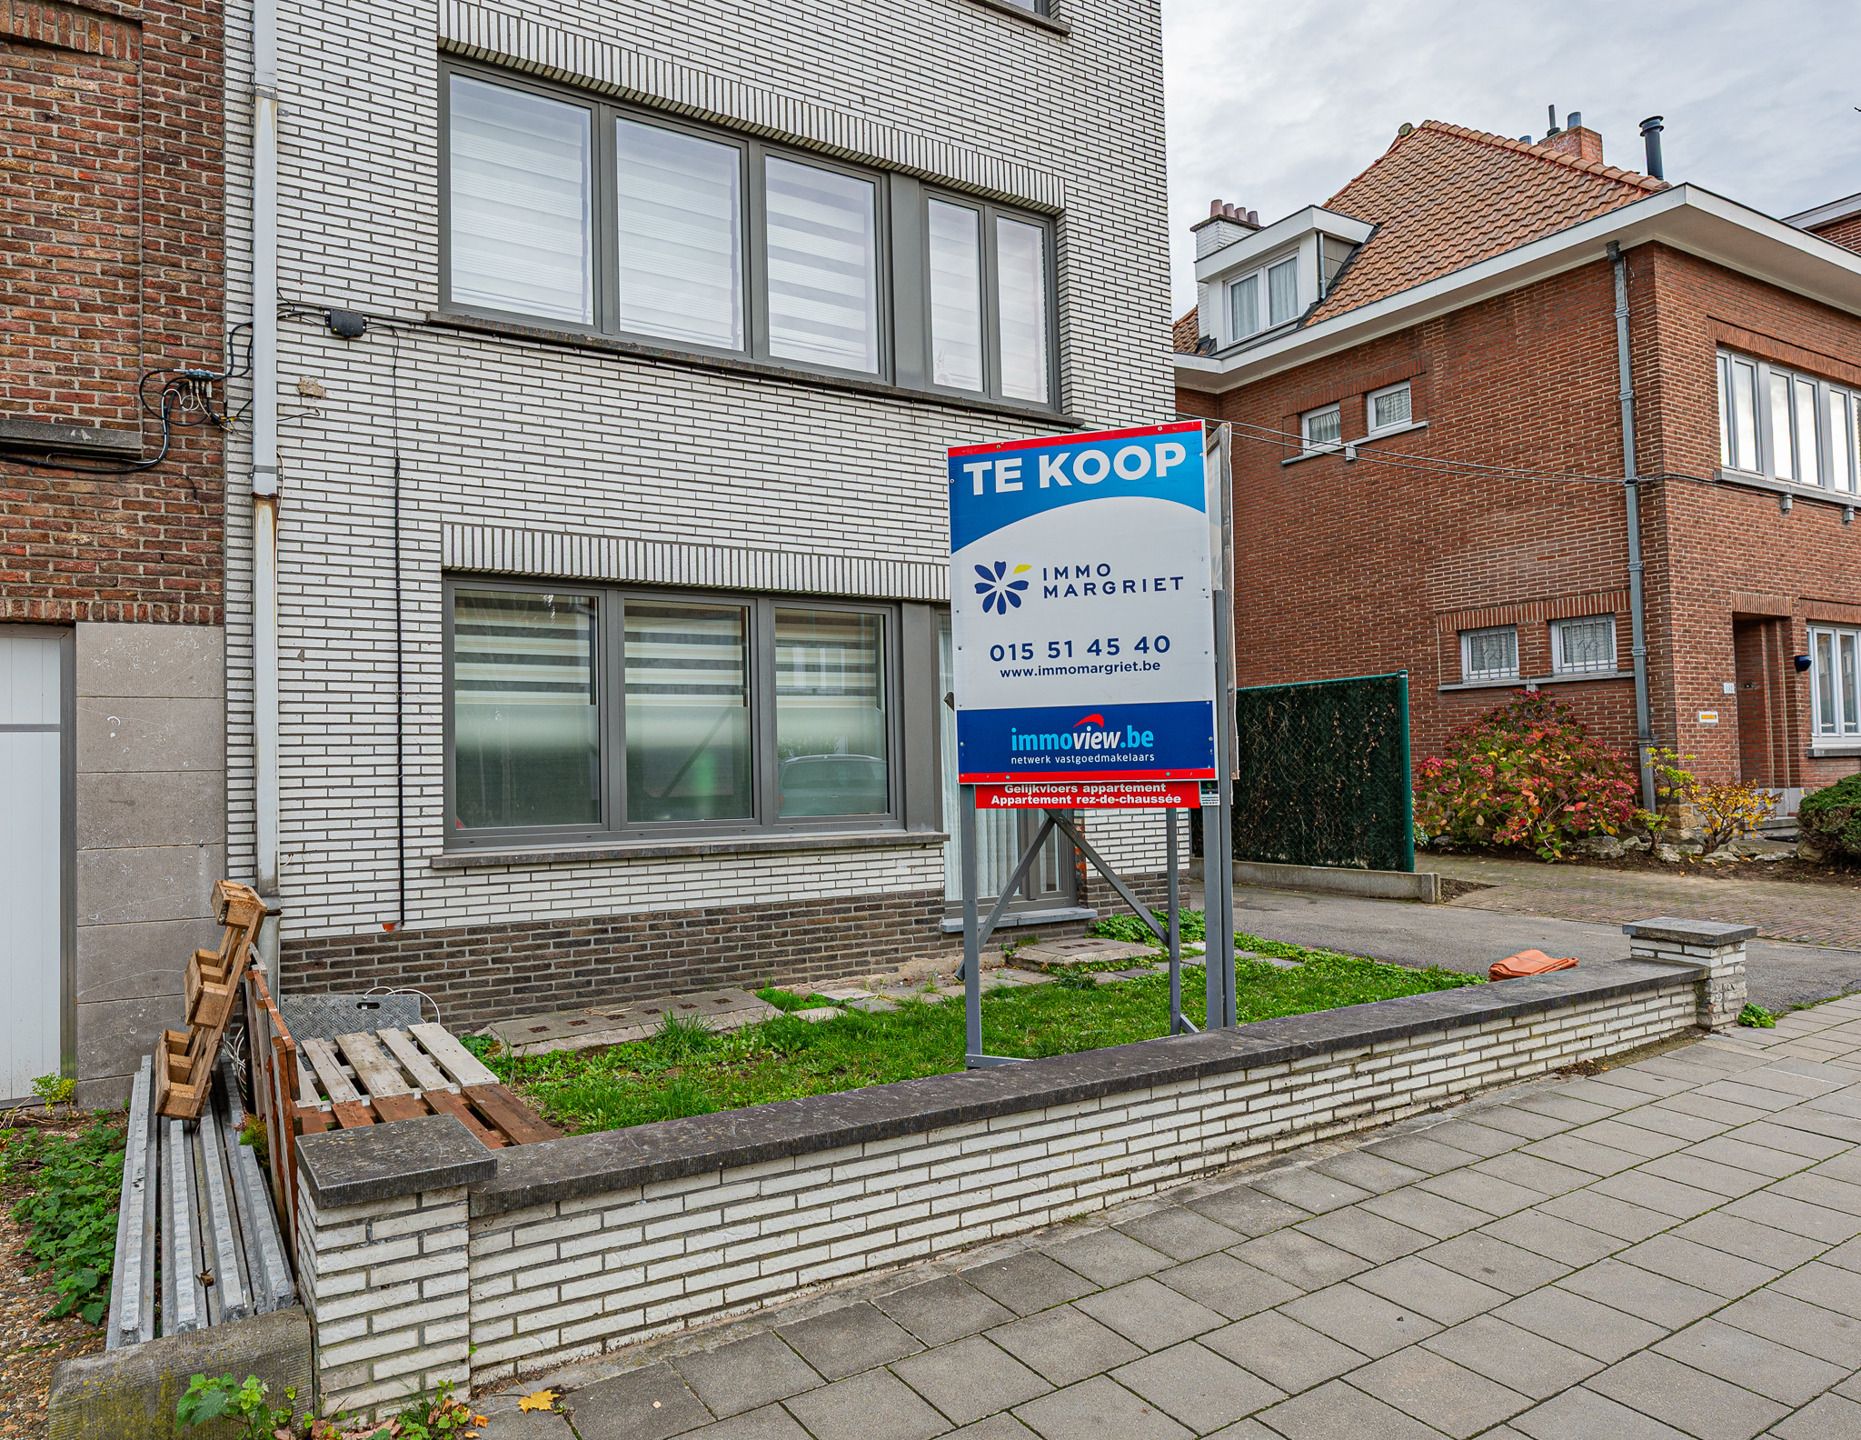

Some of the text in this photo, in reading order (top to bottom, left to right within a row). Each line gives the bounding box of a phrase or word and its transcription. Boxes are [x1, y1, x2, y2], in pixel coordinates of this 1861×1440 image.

[963, 442, 1187, 496] TE KOOP
[1043, 563, 1111, 581] IMMO
[1043, 576, 1184, 599] MARGRIET
[989, 635, 1171, 662] 015 51 45 40
[1000, 660, 1161, 678] www.immomargriet.be
[1010, 724, 1154, 751] immoview.be
[1011, 752, 1155, 765] netwerk vastgoedmakelaars
[1004, 783, 1166, 795] Gelijkvloers appartement
[991, 793, 1182, 806] Appartement rez-de-chaussée
